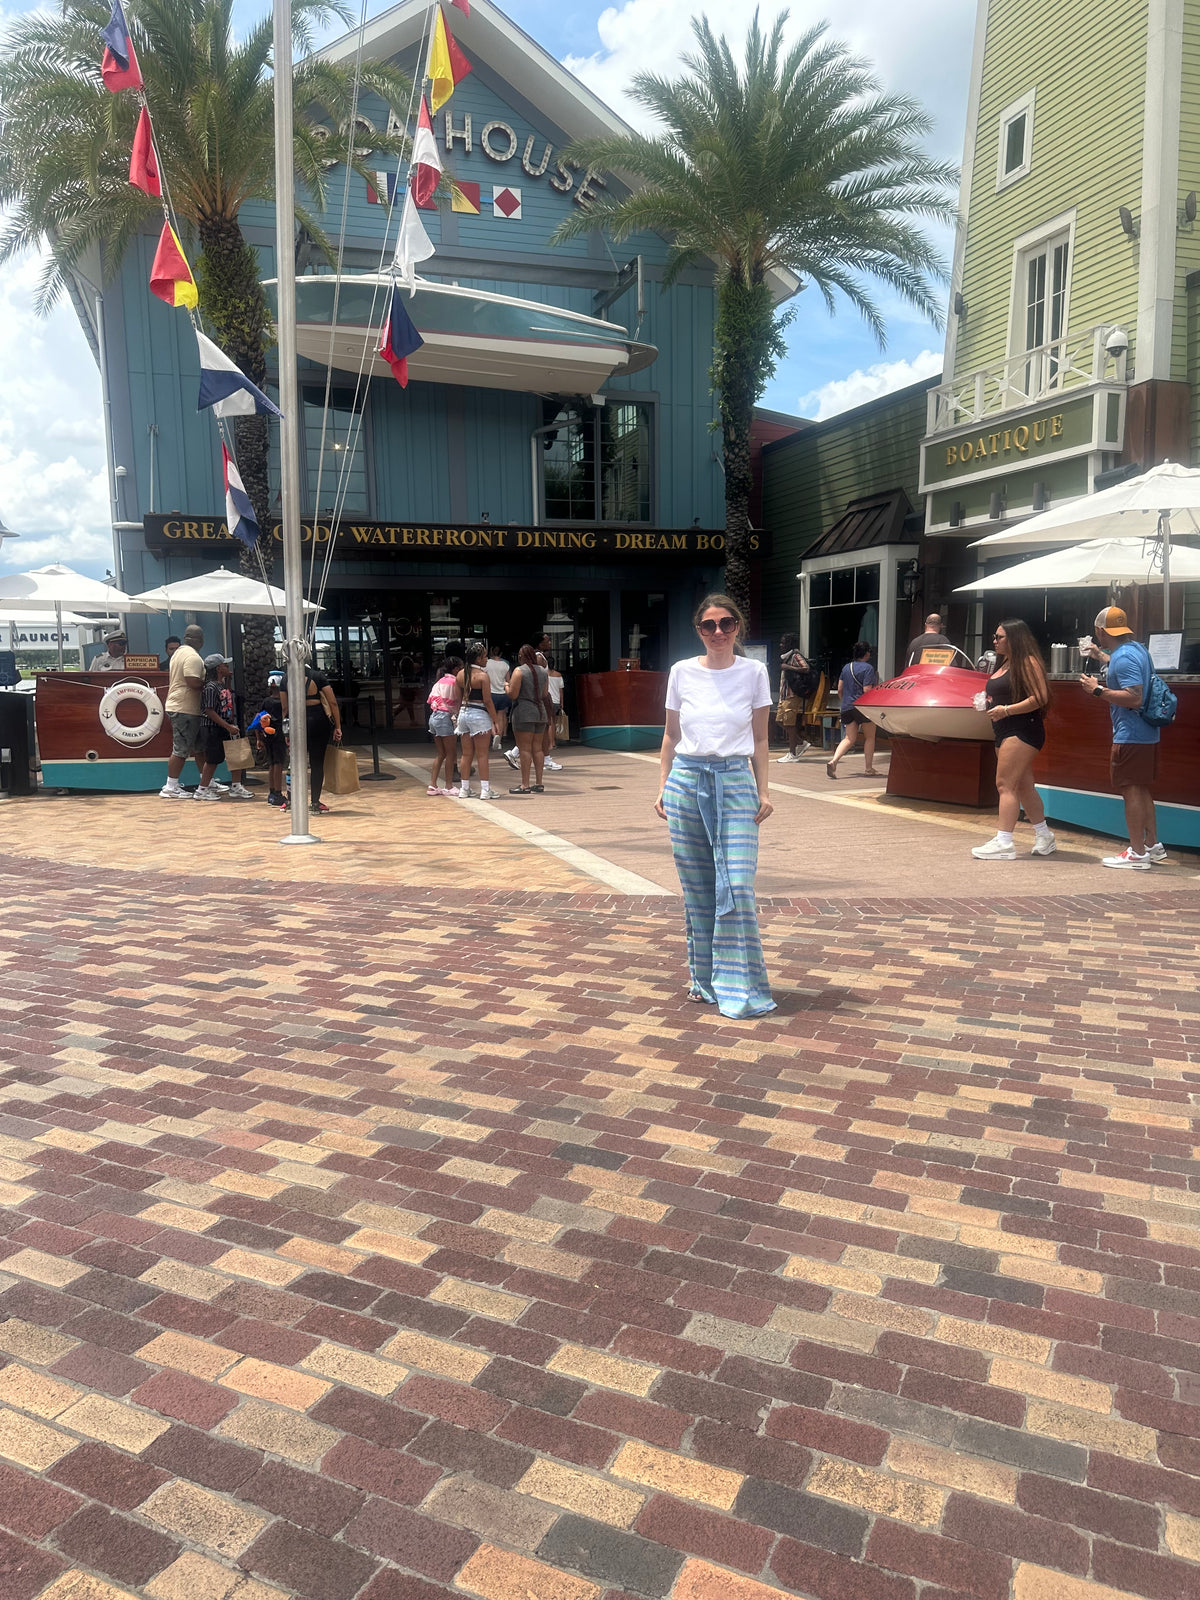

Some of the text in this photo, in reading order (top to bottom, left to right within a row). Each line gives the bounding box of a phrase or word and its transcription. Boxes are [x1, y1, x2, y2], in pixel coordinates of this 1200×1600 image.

[308, 108, 608, 212] OAHOUSE
[945, 414, 1063, 466] BOATIQUE
[162, 520, 760, 550] GREA OOD WATERFRONT DINING DREAM BOS
